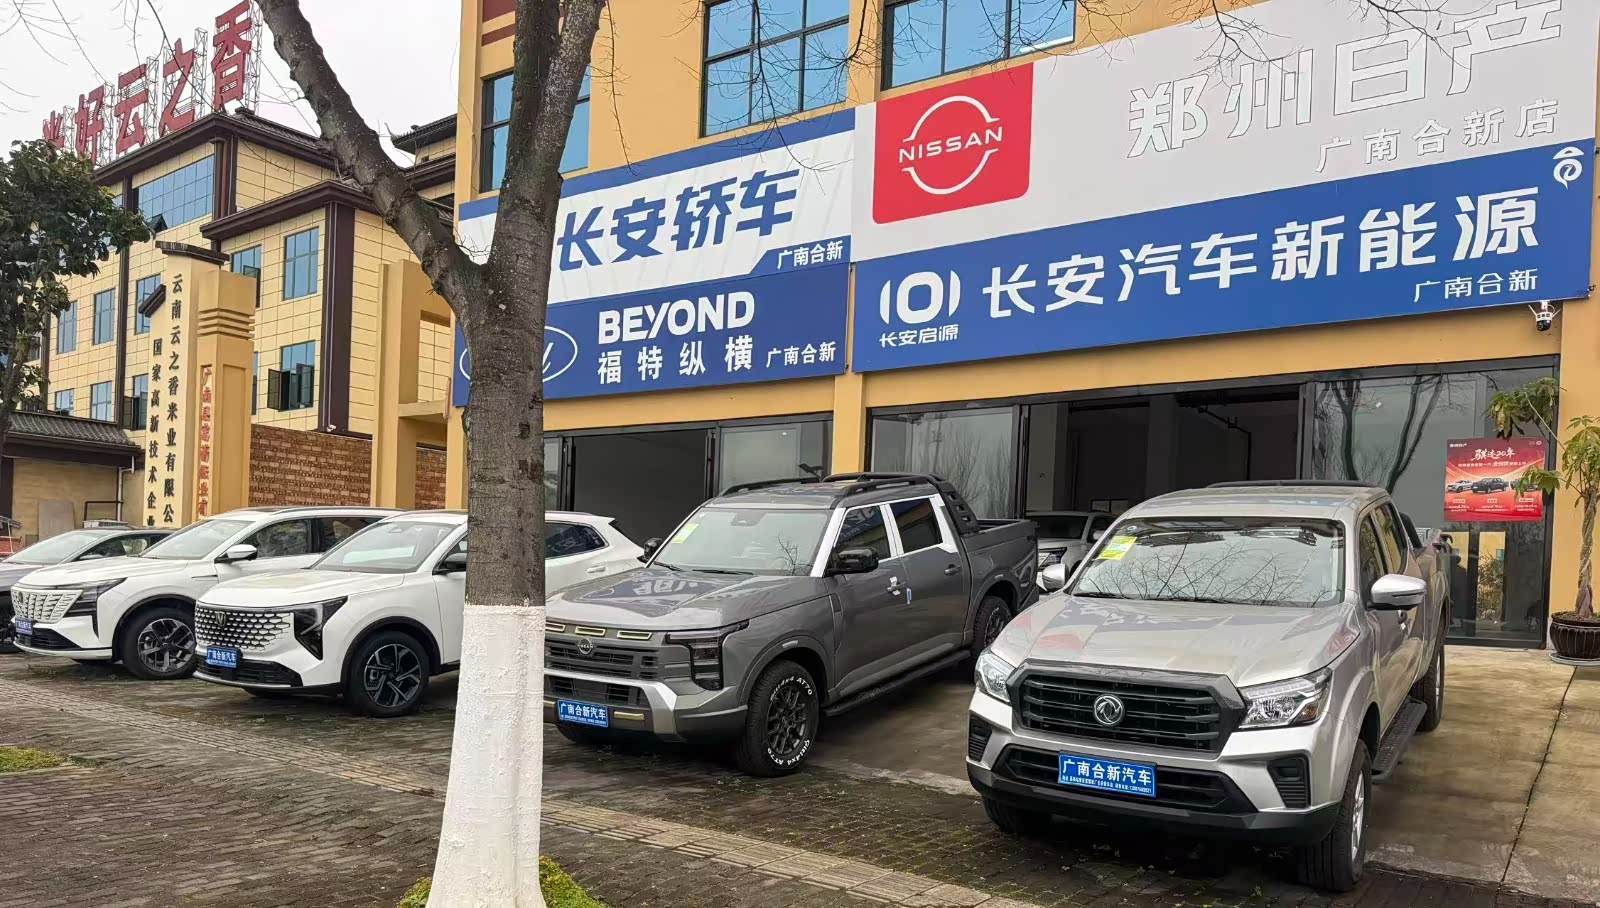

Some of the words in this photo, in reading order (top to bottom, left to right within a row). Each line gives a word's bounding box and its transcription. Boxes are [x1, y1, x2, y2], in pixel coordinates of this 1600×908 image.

[1126, 0, 1563, 159] 郑州日产
[898, 125, 1004, 164] NISSAN
[1315, 97, 1559, 174] 广南合新店
[556, 169, 800, 272] 长安轿车
[776, 241, 844, 271] 广南合新
[982, 186, 1540, 319] 长安汽车新能源
[1413, 267, 1539, 303] 广南合新
[597, 291, 756, 345] BEYOND
[879, 323, 960, 349] 长安启源
[597, 334, 754, 385] 福特纵横
[766, 340, 838, 369] 广南合新
[560, 702, 606, 720] 广南合新汽车
[1062, 759, 1152, 786] 广南合新汽车
